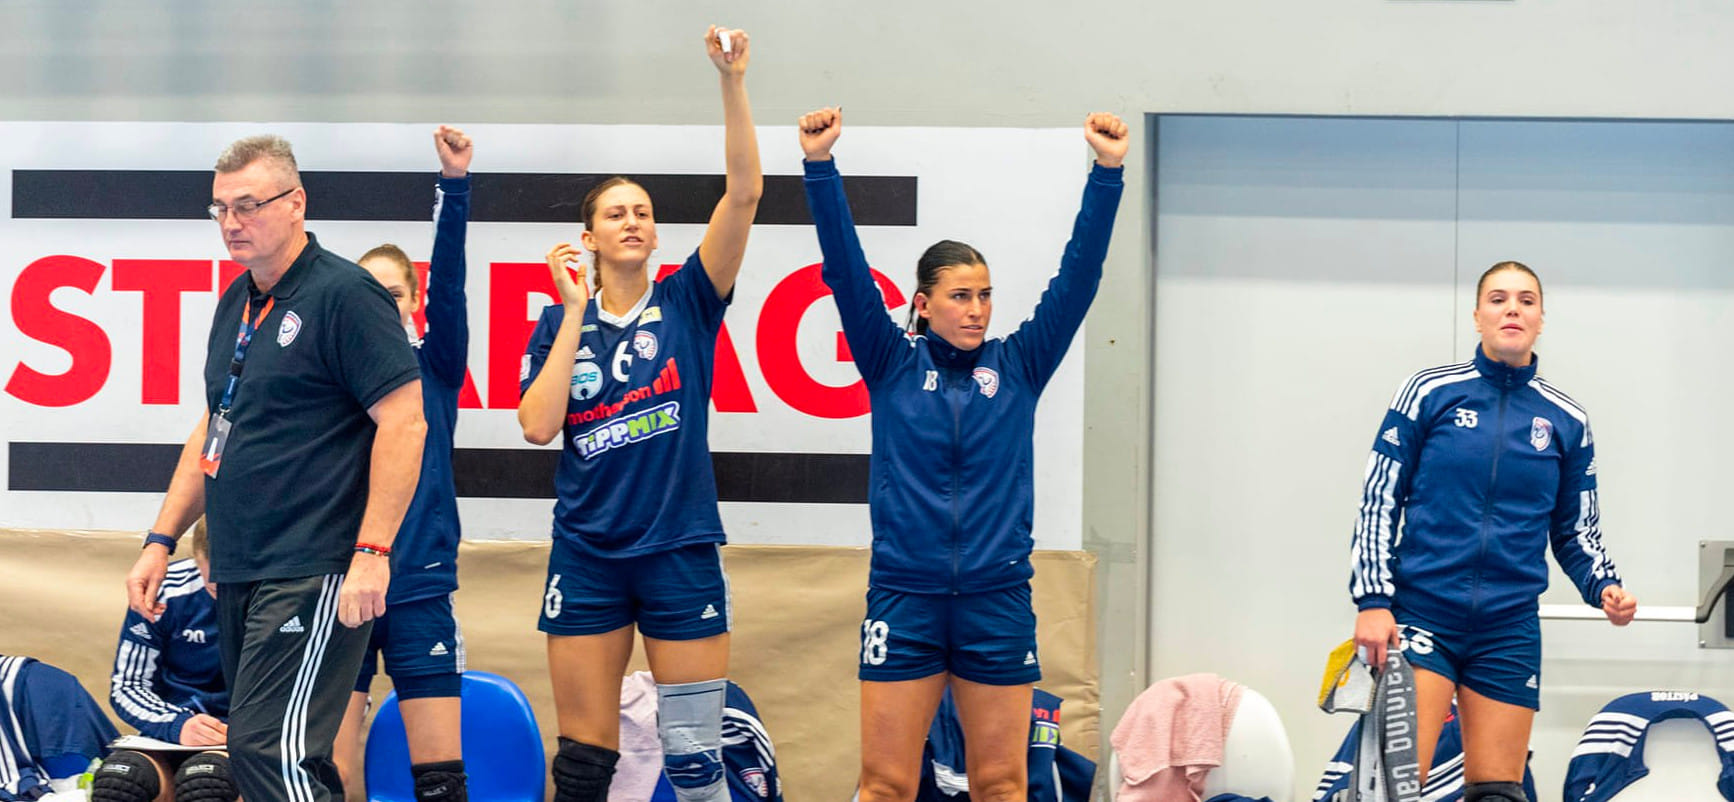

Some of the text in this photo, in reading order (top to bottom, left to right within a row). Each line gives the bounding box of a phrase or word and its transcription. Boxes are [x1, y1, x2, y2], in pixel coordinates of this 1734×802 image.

[612, 341, 634, 383] 6
[922, 370, 939, 391] 18
[1455, 408, 1478, 429] 33
[544, 574, 563, 619] 6
[863, 619, 890, 666] 18
